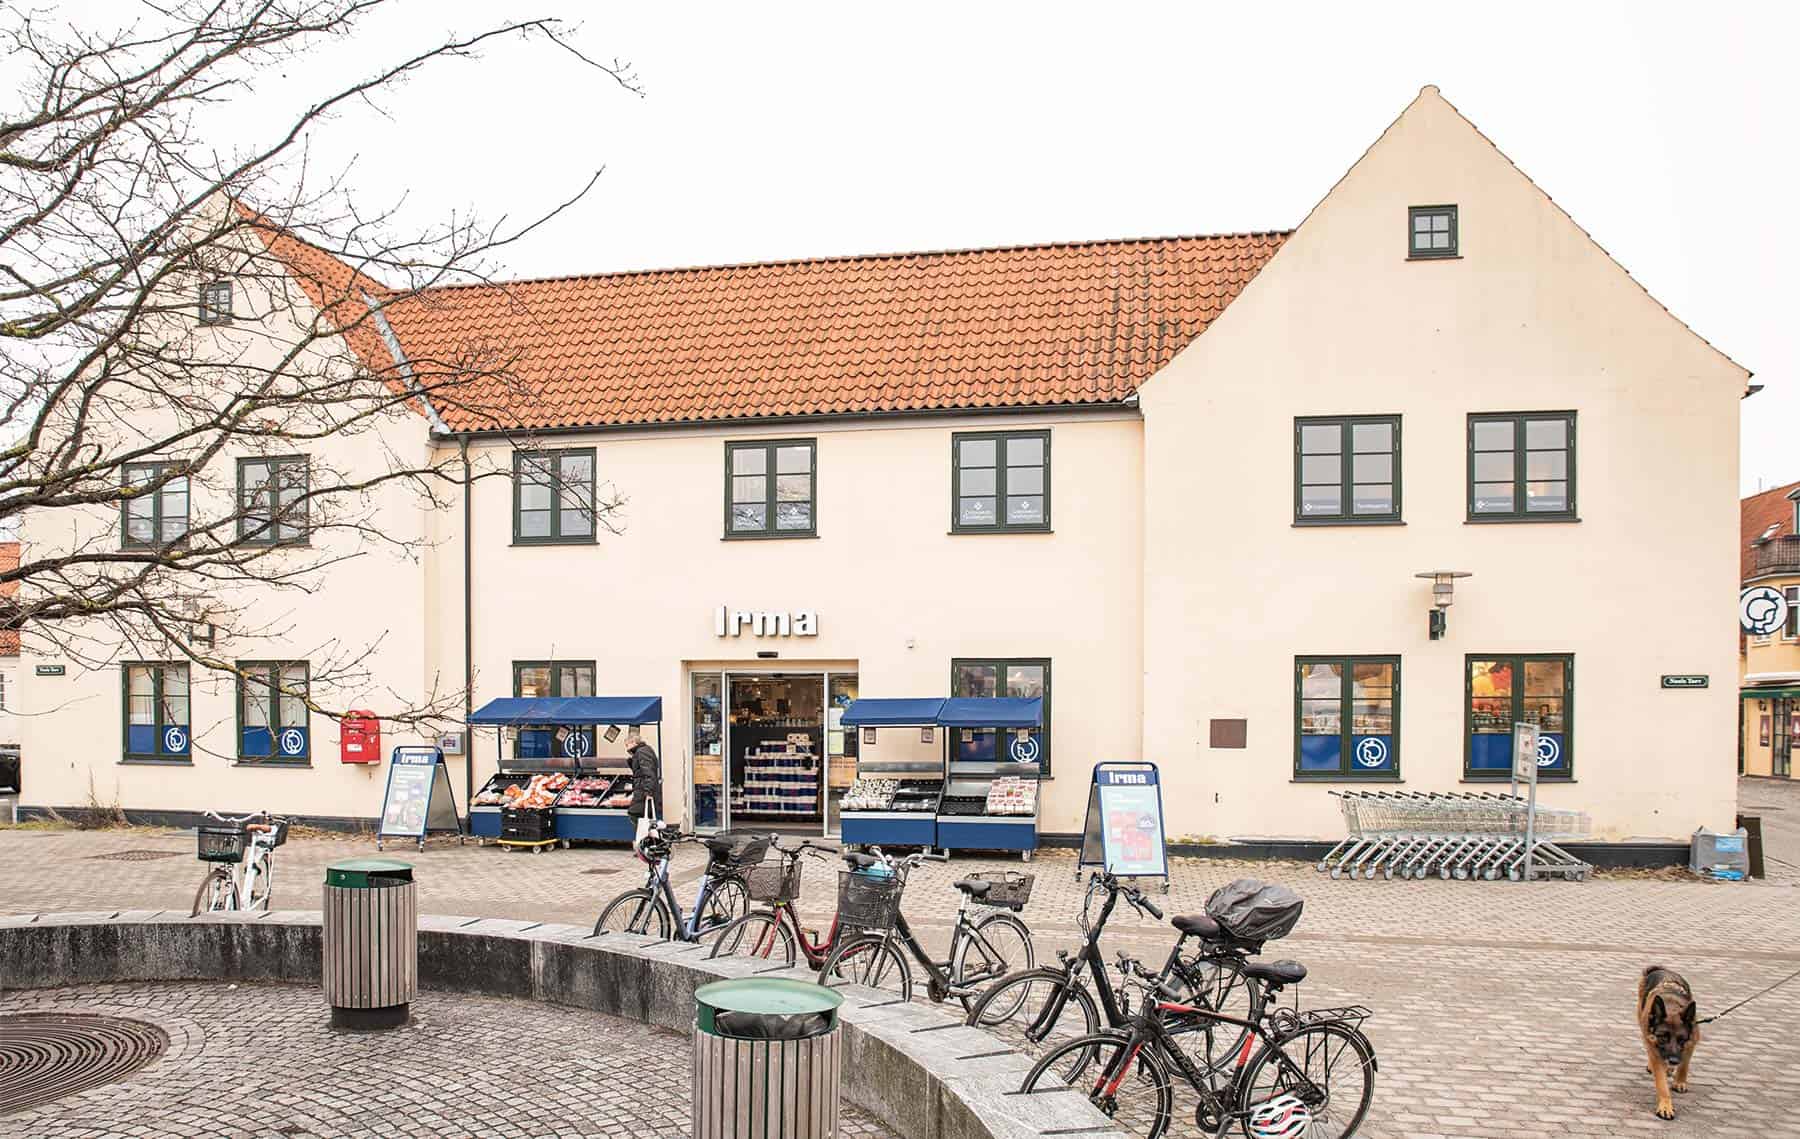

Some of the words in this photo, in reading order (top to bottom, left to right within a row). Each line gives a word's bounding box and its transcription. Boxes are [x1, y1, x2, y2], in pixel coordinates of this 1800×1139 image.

[715, 604, 818, 638] Irma
[401, 753, 429, 764] Irma
[1109, 771, 1147, 784] Irma
